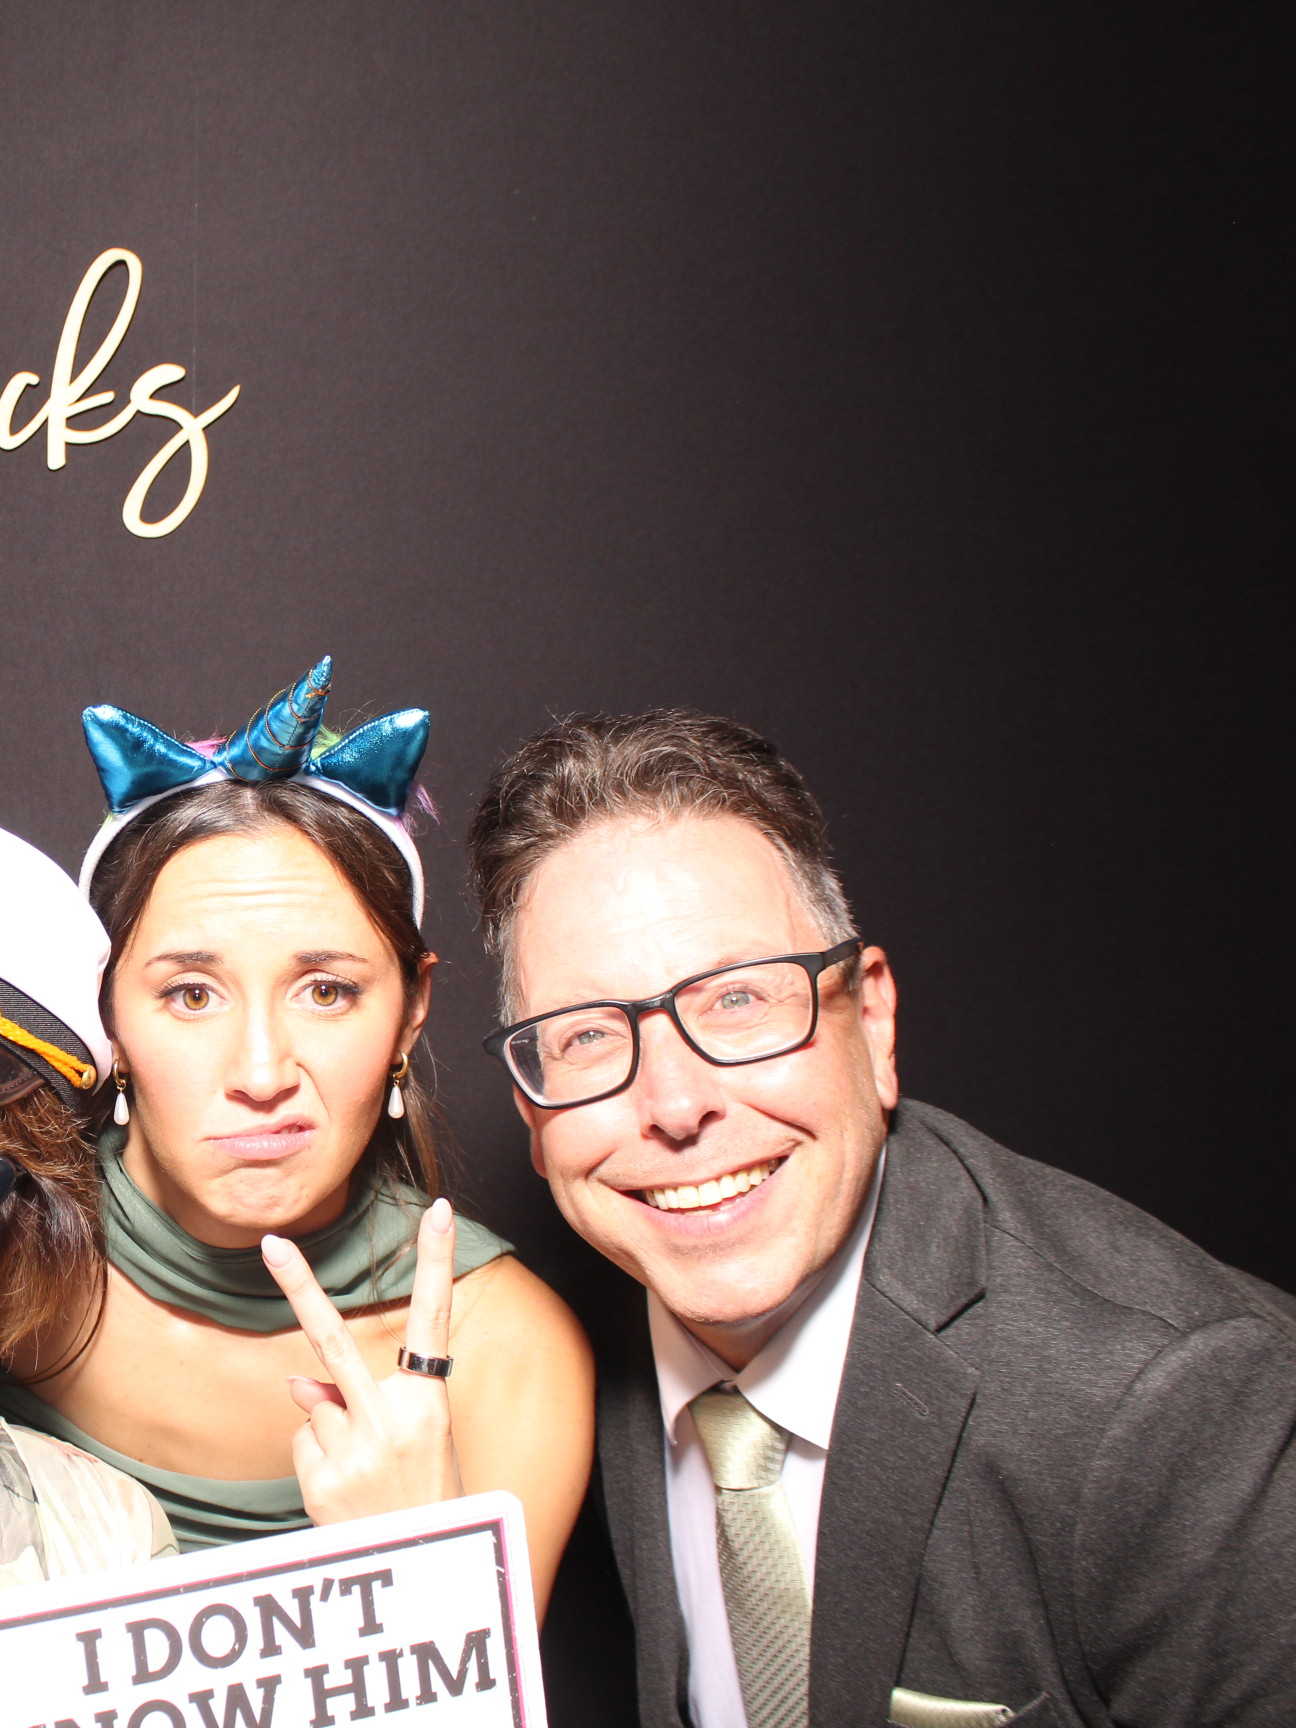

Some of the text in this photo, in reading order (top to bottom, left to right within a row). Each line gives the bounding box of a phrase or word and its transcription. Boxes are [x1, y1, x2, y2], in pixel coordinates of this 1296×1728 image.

[75, 1568, 394, 1696] I DON'T
[303, 1628, 497, 1728] HIM
